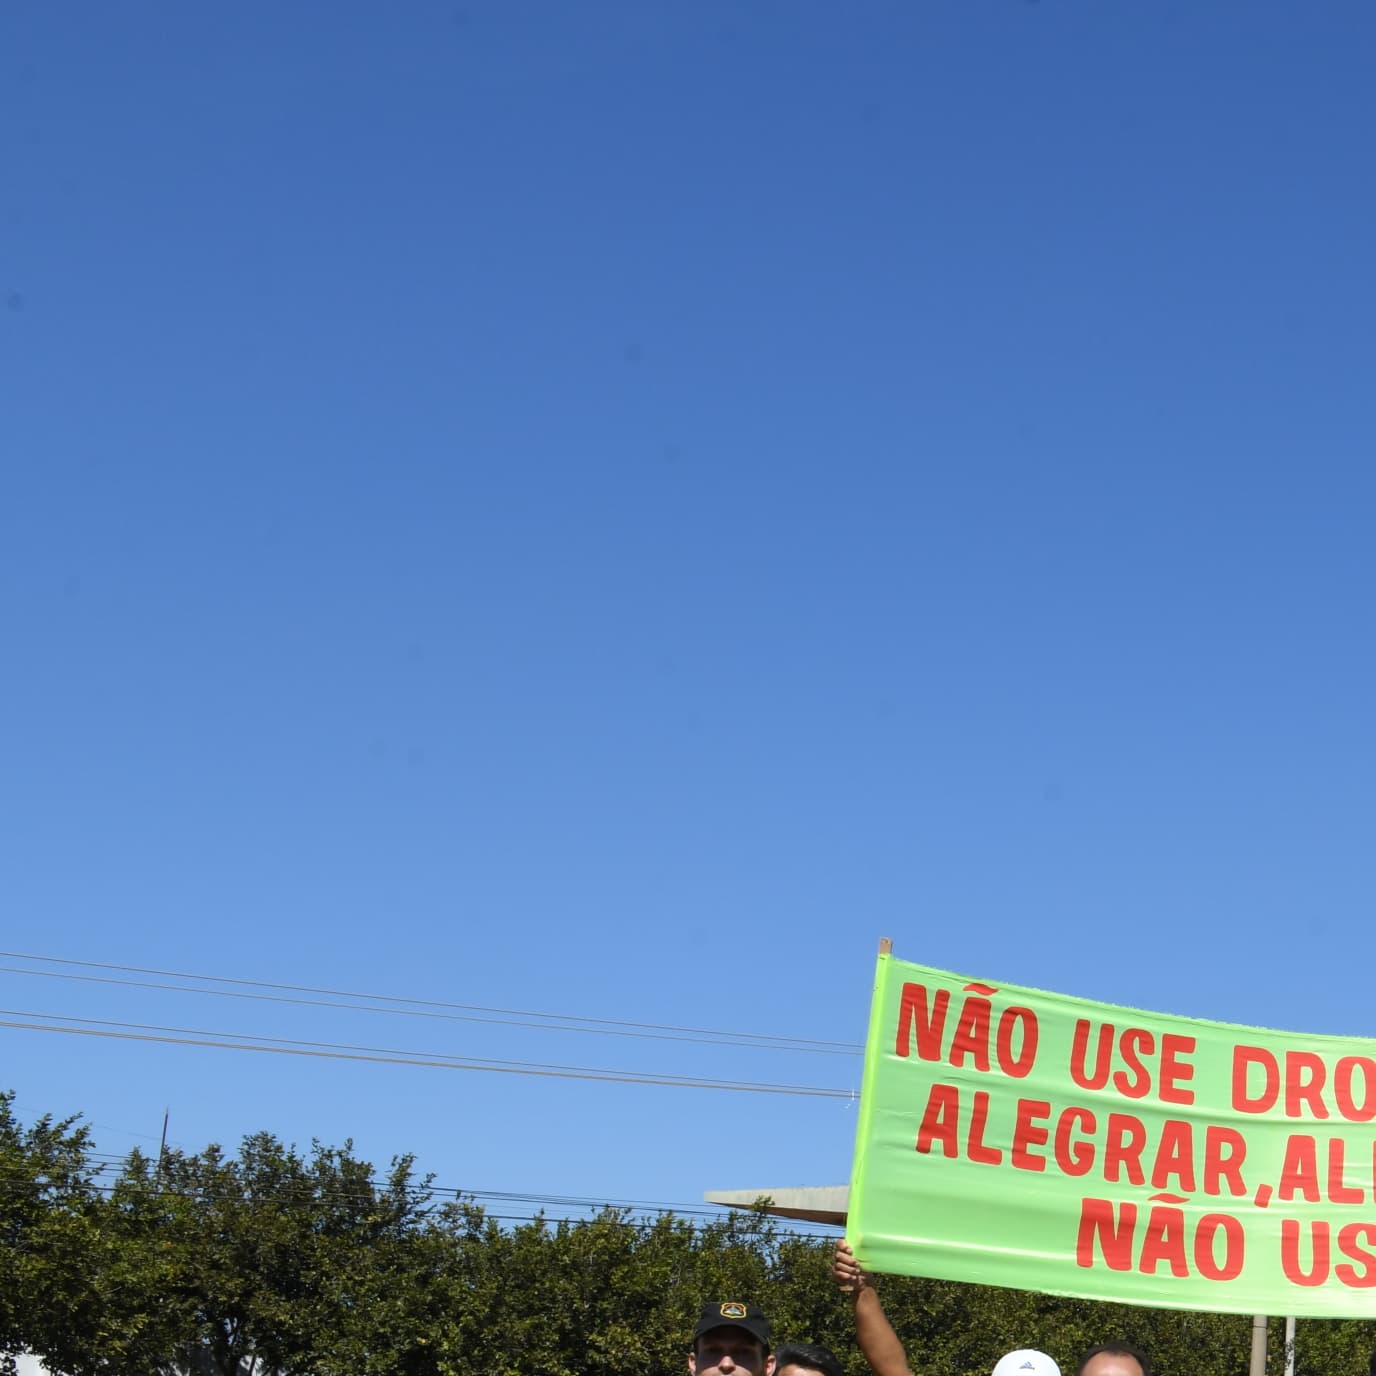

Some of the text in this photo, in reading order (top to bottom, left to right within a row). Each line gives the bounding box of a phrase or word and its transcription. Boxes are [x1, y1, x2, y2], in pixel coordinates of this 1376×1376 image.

[896, 982, 1039, 1079] NÃO
[1070, 1019, 1196, 1105] USE
[1076, 1192, 1245, 1281] NÃO
